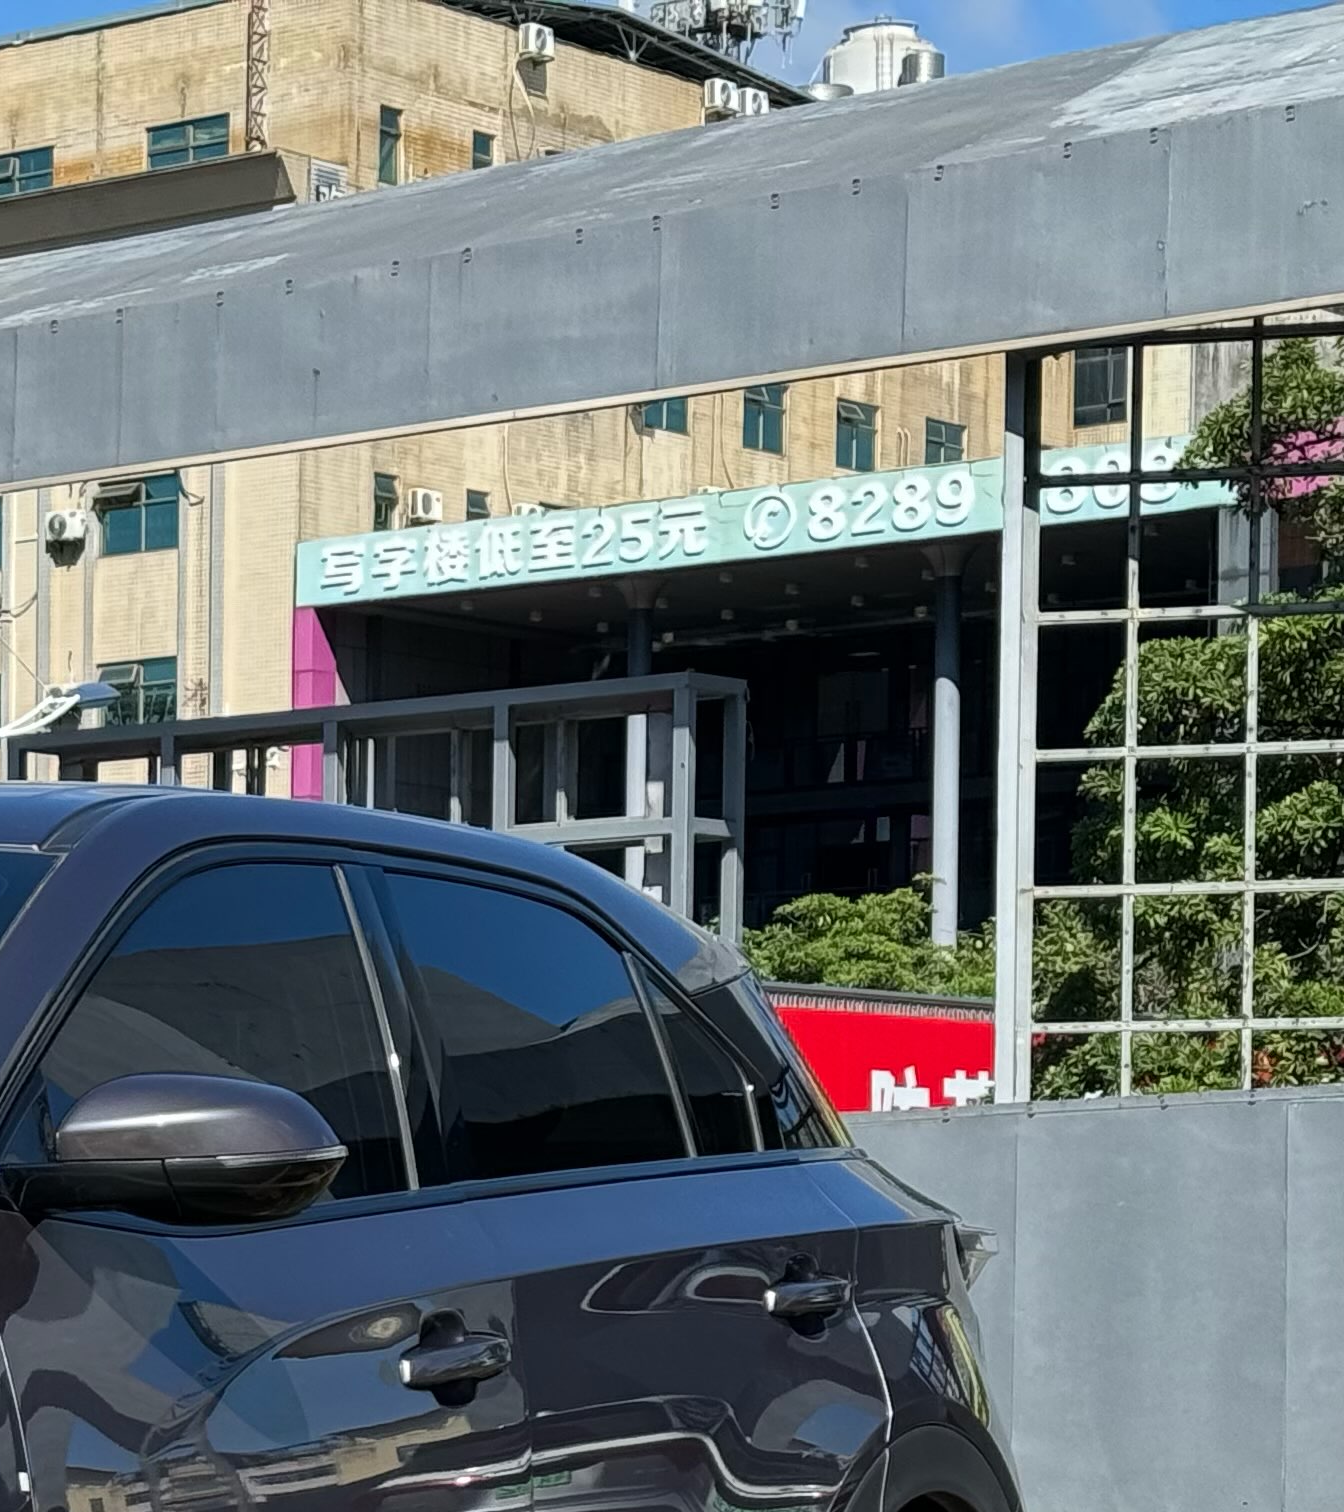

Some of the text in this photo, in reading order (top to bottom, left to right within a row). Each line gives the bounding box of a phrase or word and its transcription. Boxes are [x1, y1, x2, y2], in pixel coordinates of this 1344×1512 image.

[319, 501, 709, 596] 写字楼低至25元
[807, 470, 976, 542] 8289
